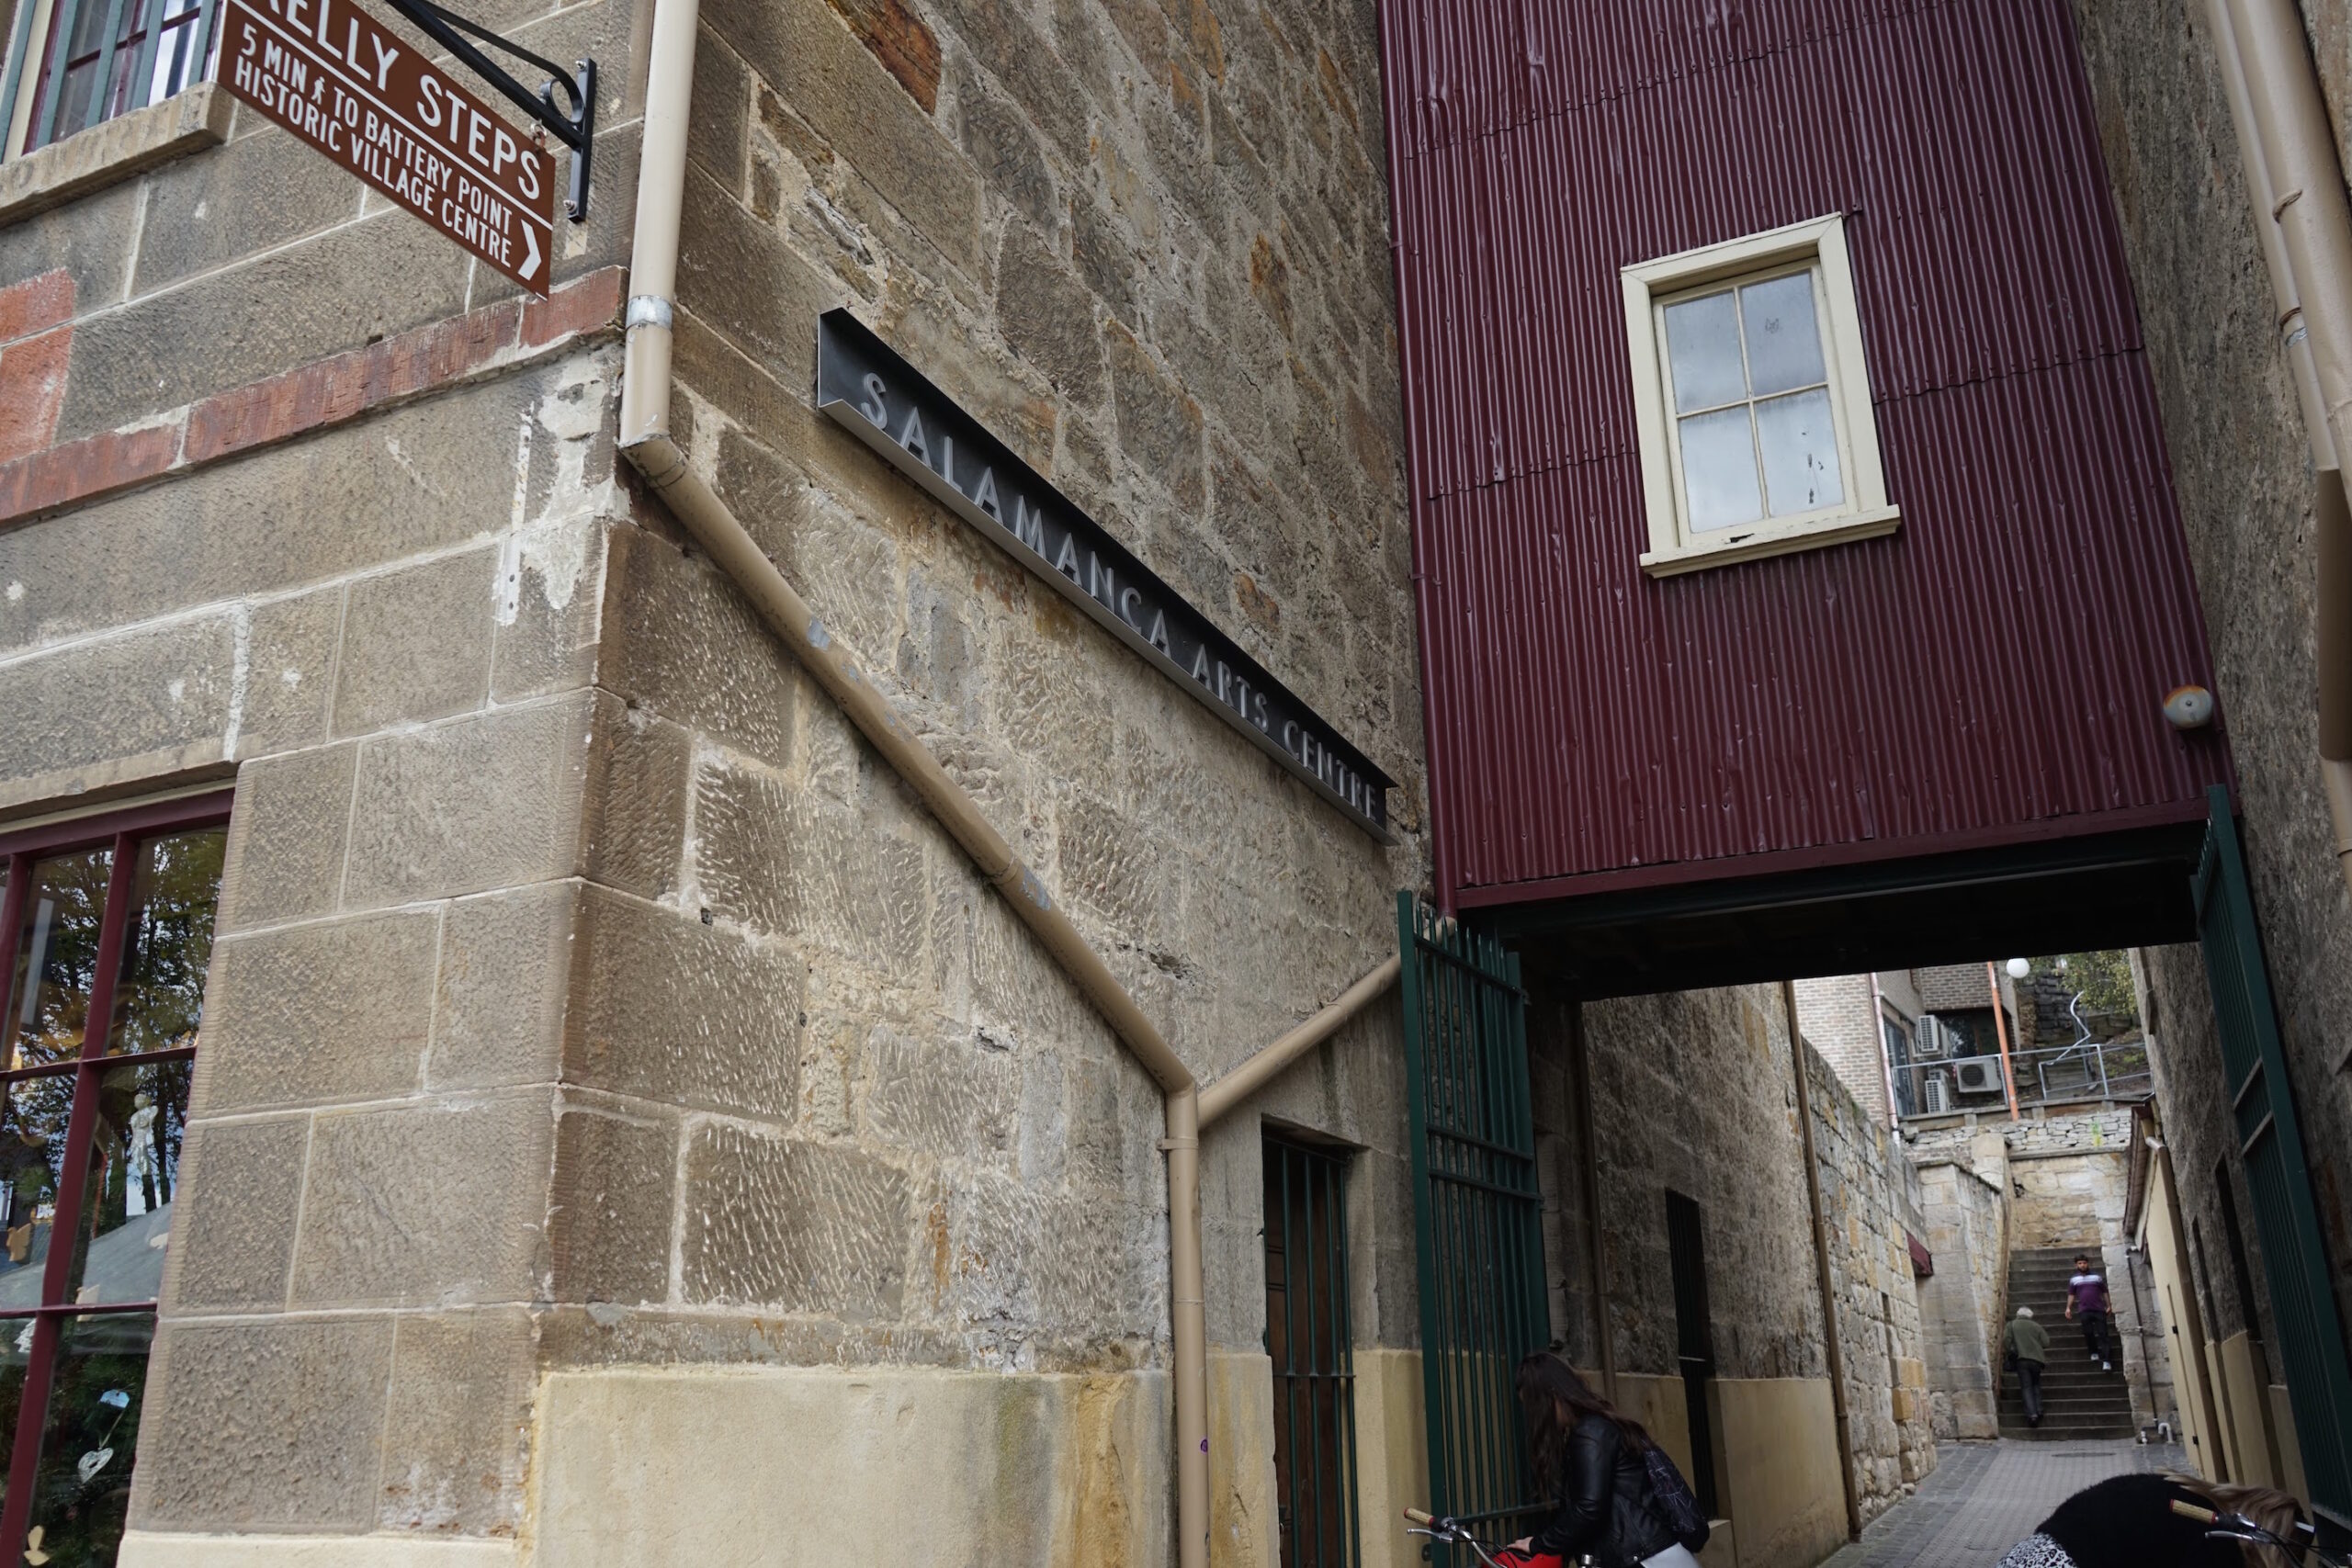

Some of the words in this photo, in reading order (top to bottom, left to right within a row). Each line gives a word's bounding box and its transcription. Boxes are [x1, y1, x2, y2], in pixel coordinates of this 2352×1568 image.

[234, 55, 342, 152] HISTORIC
[351, 133, 435, 216] VILLAGE
[442, 200, 512, 267] CENTRE
[241, 23, 257, 56] 5
[264, 39, 307, 94] MIN
[334, 86, 358, 129] TO
[366, 111, 452, 192] BATTERY
[458, 176, 512, 234] POINT
[269, 0, 399, 91] ELLY
[417, 75, 540, 199] STEPS
[861, 373, 1170, 656] SALAMANCA
[1193, 645, 1269, 734] ARTS
[1284, 720, 1375, 818] CENTRE
